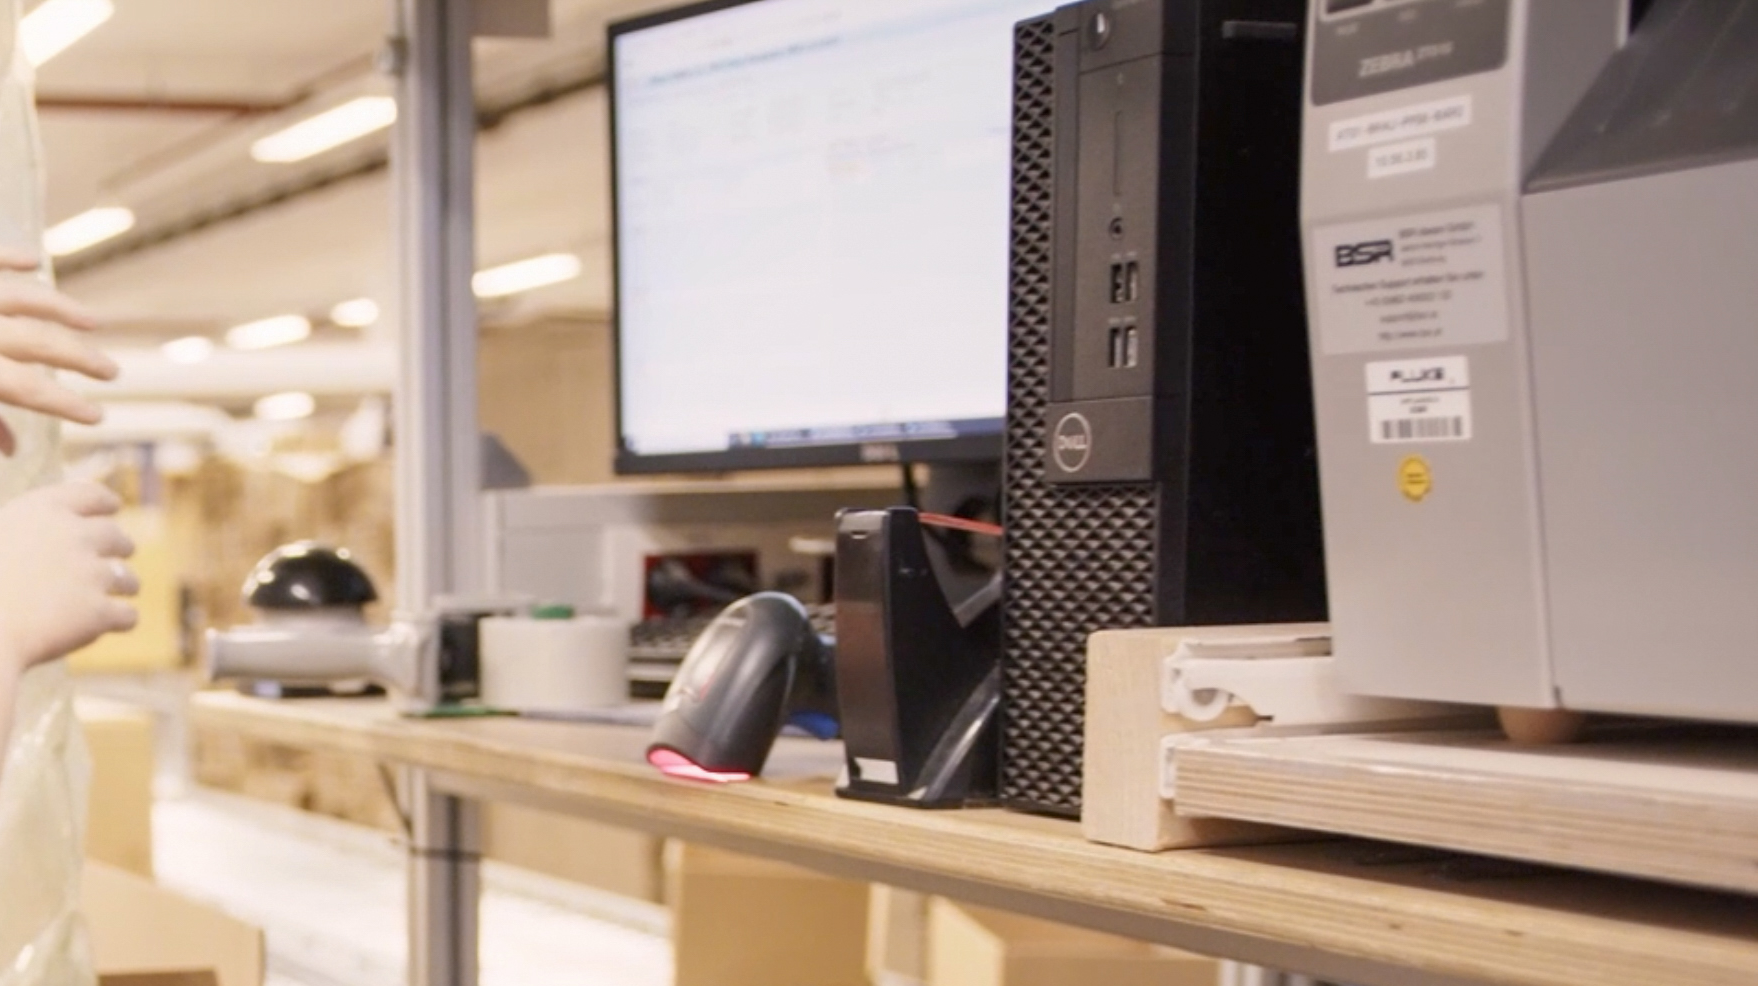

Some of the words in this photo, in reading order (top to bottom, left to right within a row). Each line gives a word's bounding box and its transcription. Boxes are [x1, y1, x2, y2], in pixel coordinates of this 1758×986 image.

[1359, 49, 1415, 78] ZEBRA
[1335, 239, 1394, 267] BSR
[1058, 434, 1088, 450] DELL
